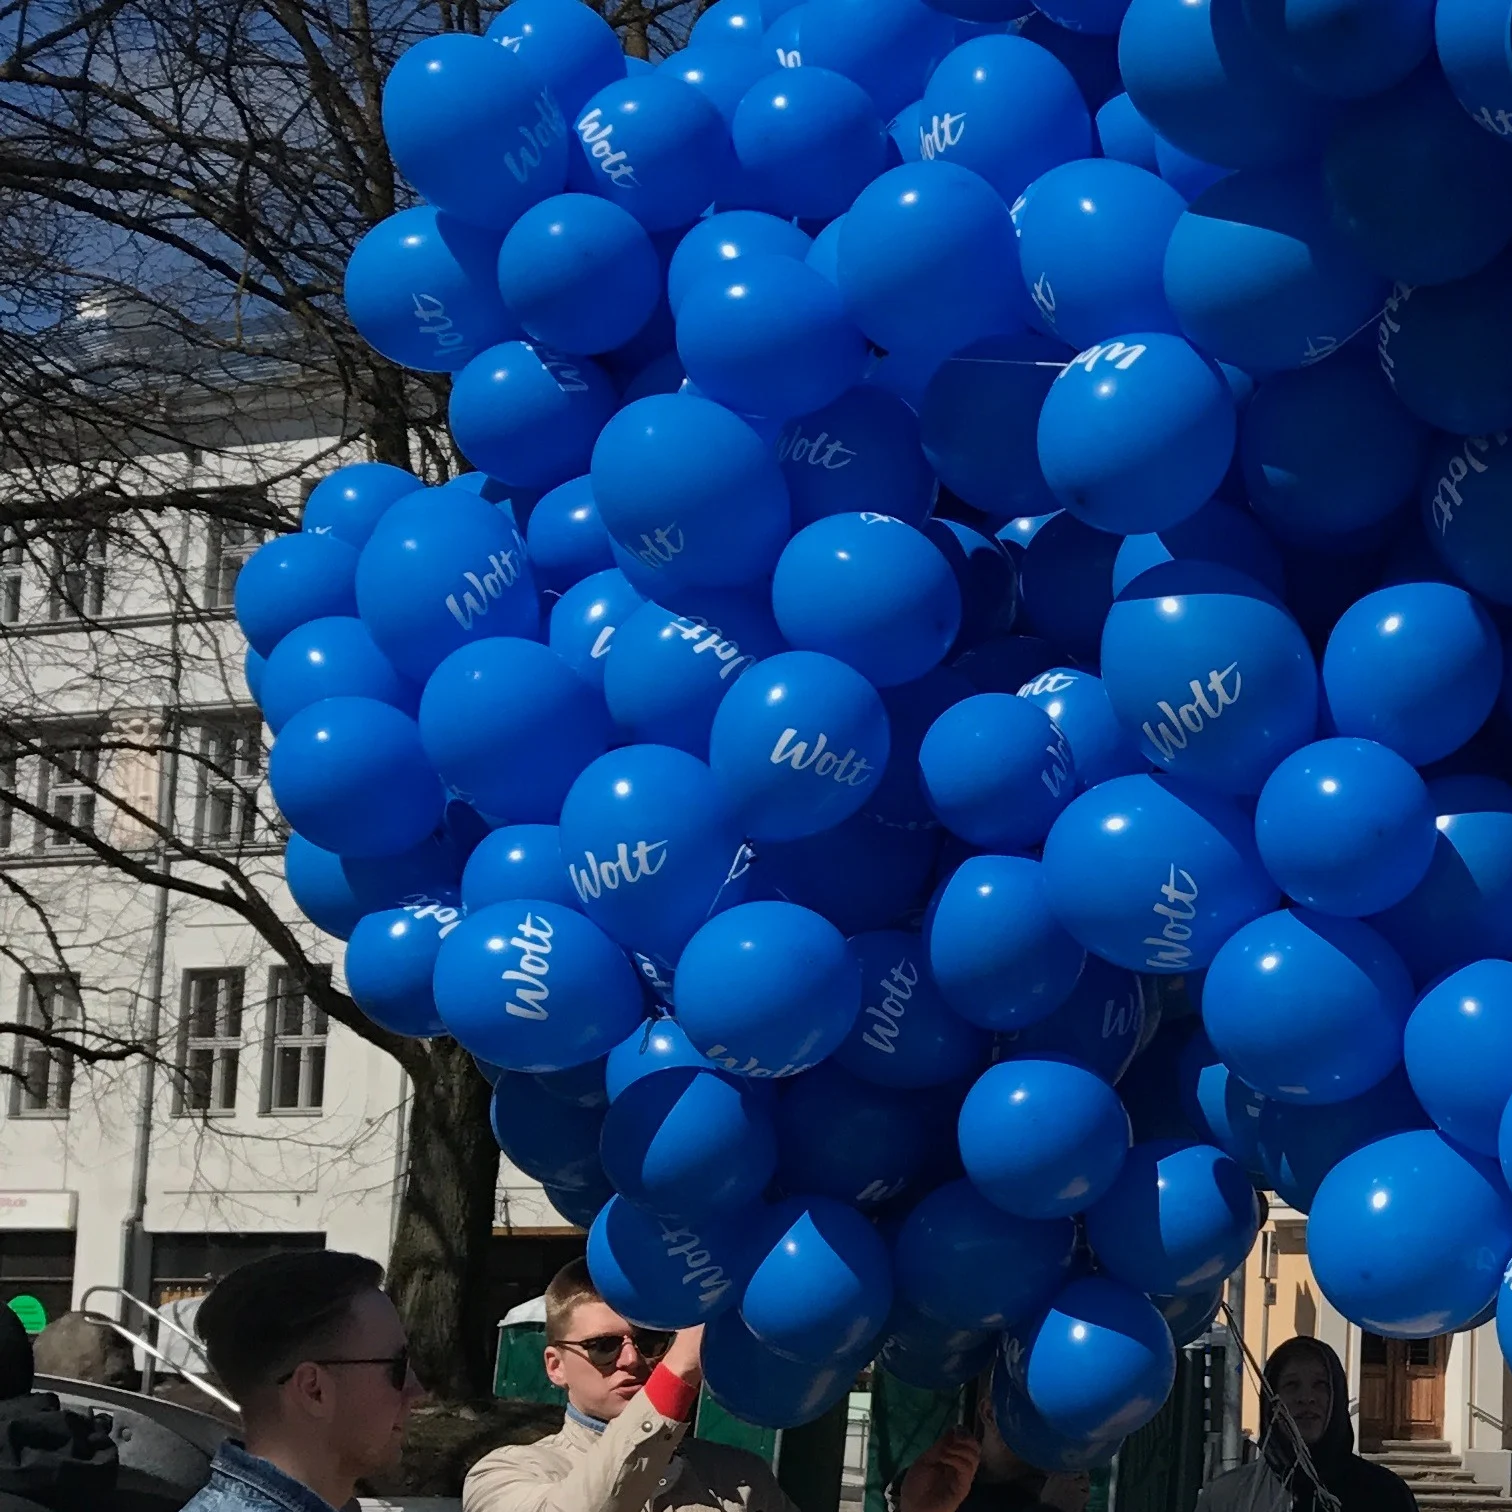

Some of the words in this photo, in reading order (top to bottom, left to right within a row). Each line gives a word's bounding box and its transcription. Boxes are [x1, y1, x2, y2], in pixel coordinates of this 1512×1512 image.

[577, 107, 642, 190] Wolt
[446, 529, 527, 630] Wolt
[769, 727, 875, 787] Wolt
[1142, 661, 1242, 764] Wolt
[569, 840, 669, 904] Wolt
[1142, 862, 1199, 969] Wolt
[505, 911, 555, 1021] Wolt
[862, 956, 919, 1055] Wolt
